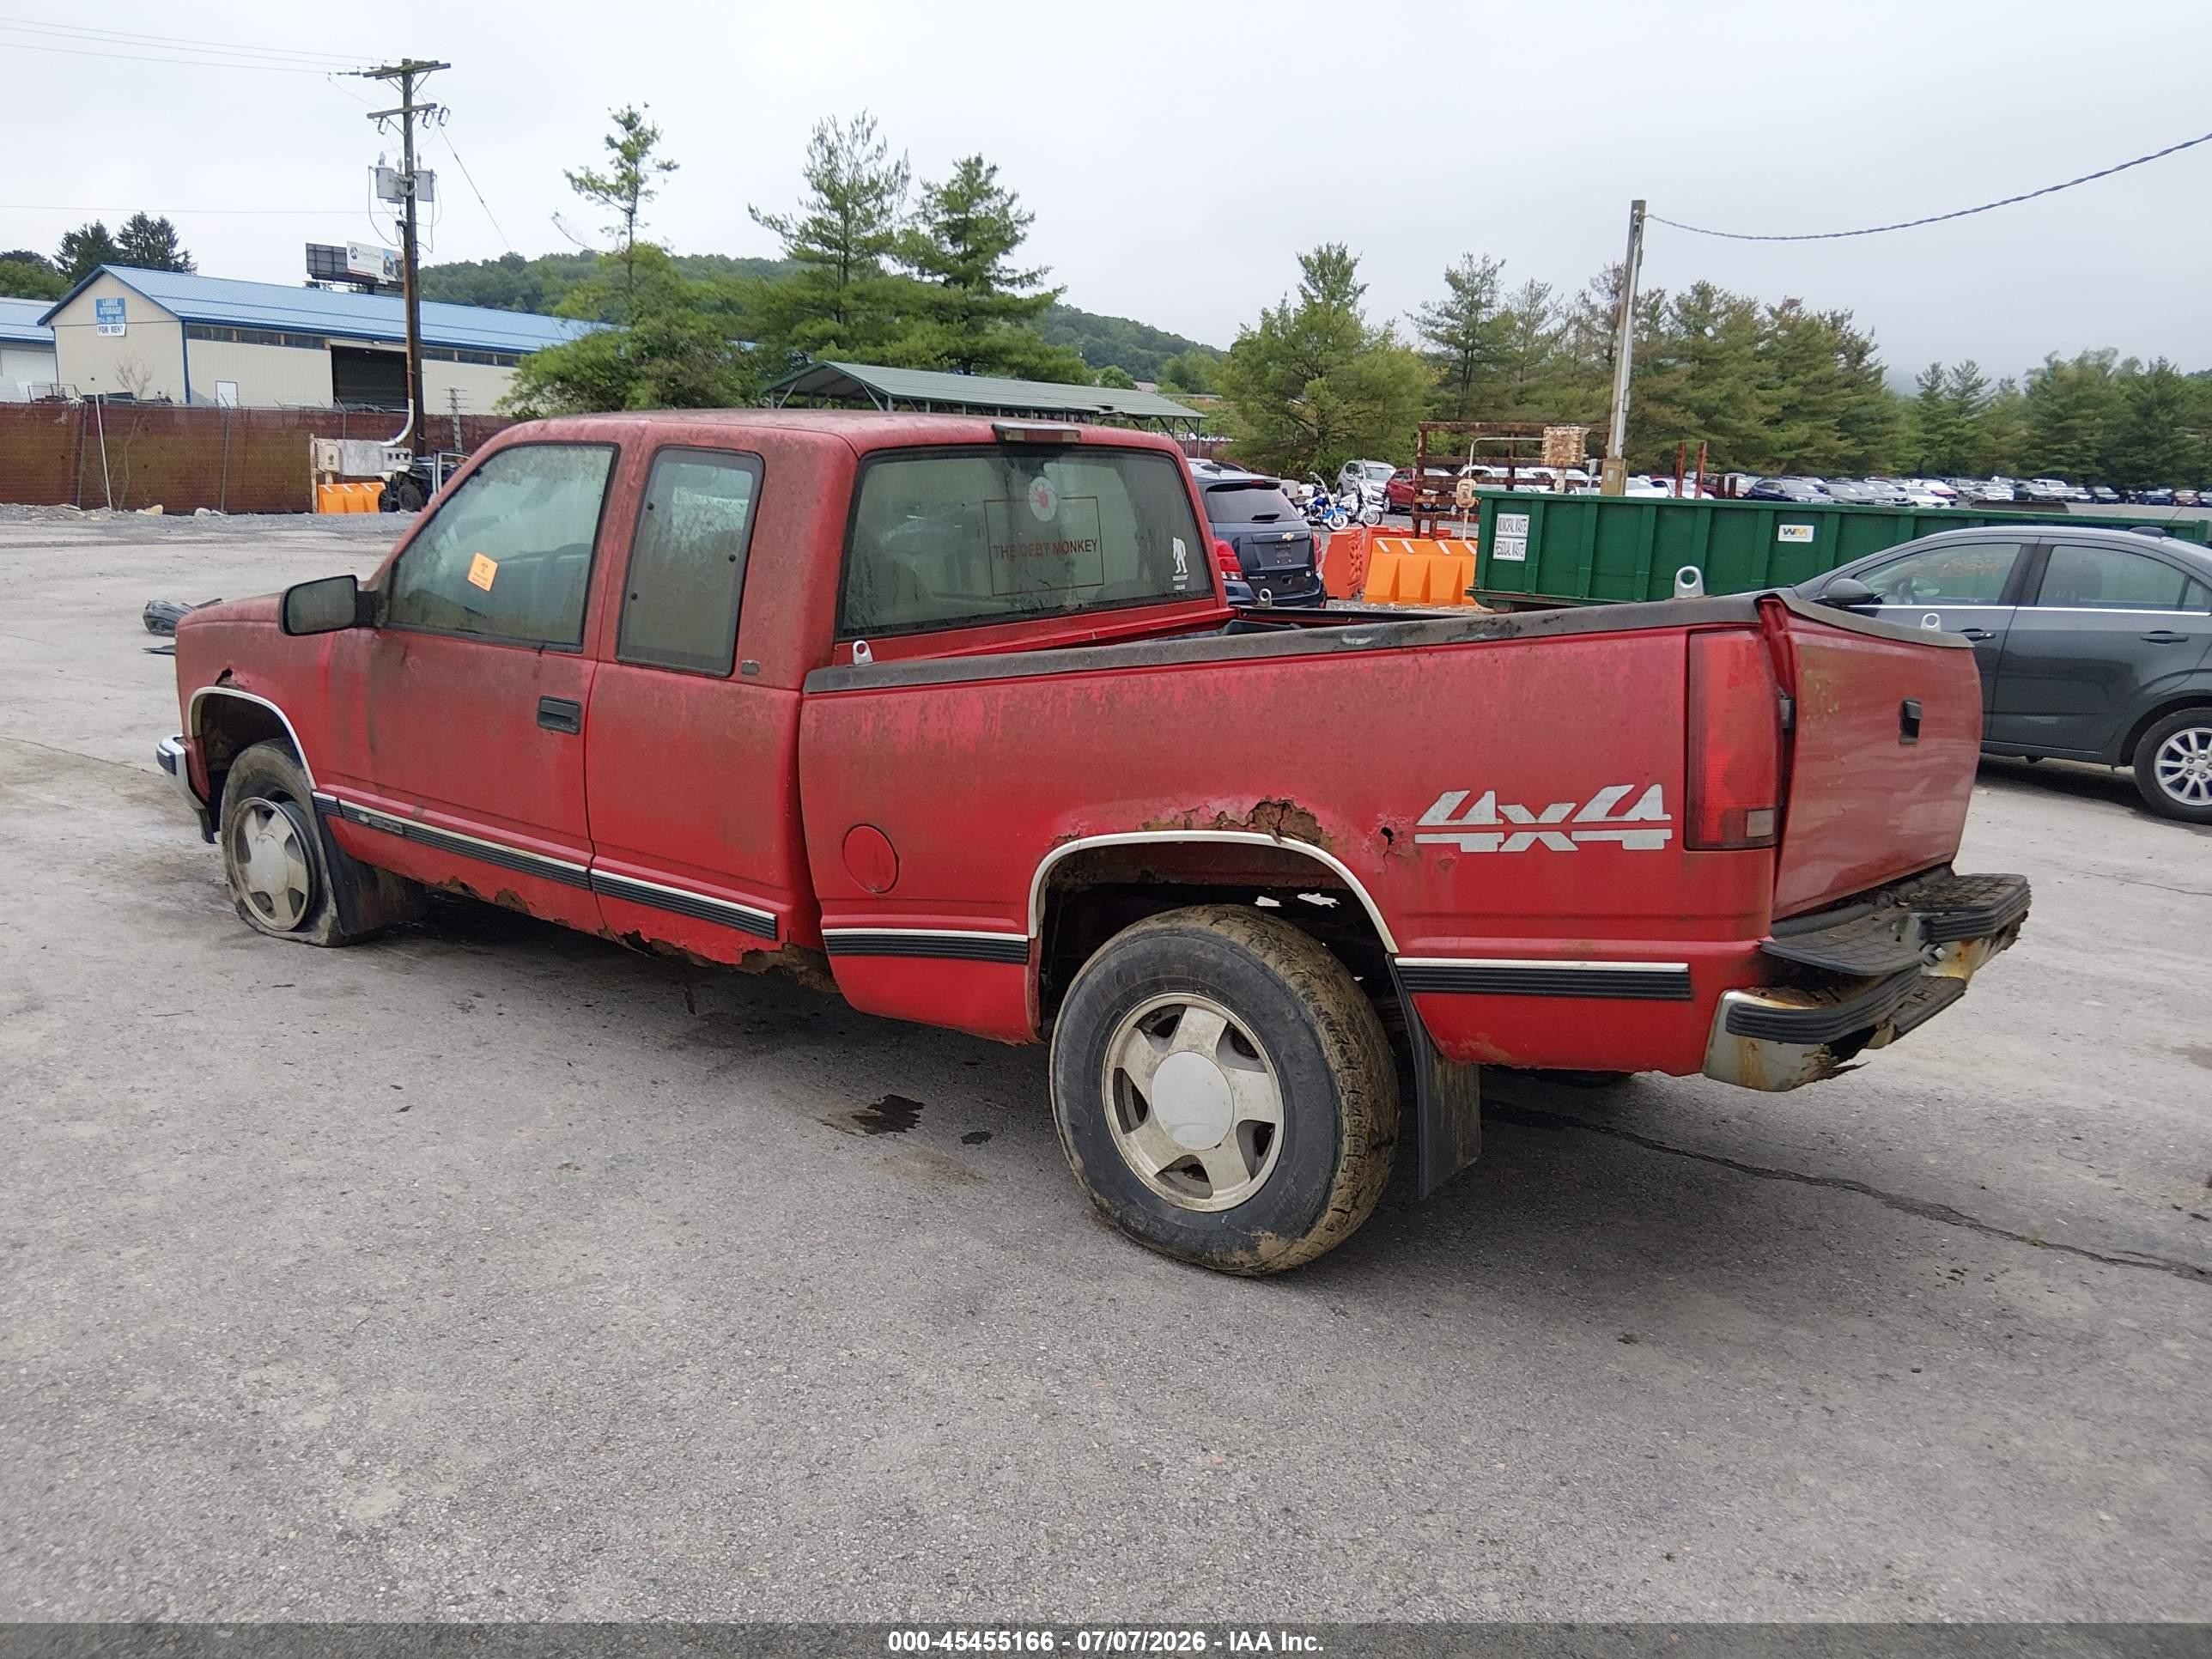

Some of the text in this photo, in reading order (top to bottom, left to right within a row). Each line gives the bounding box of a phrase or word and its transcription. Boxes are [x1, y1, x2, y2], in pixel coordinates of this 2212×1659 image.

[111, 325, 124, 333] RENT
[1783, 527, 1808, 537] WM
[993, 538, 1098, 559] THE DEBT MONKEY
